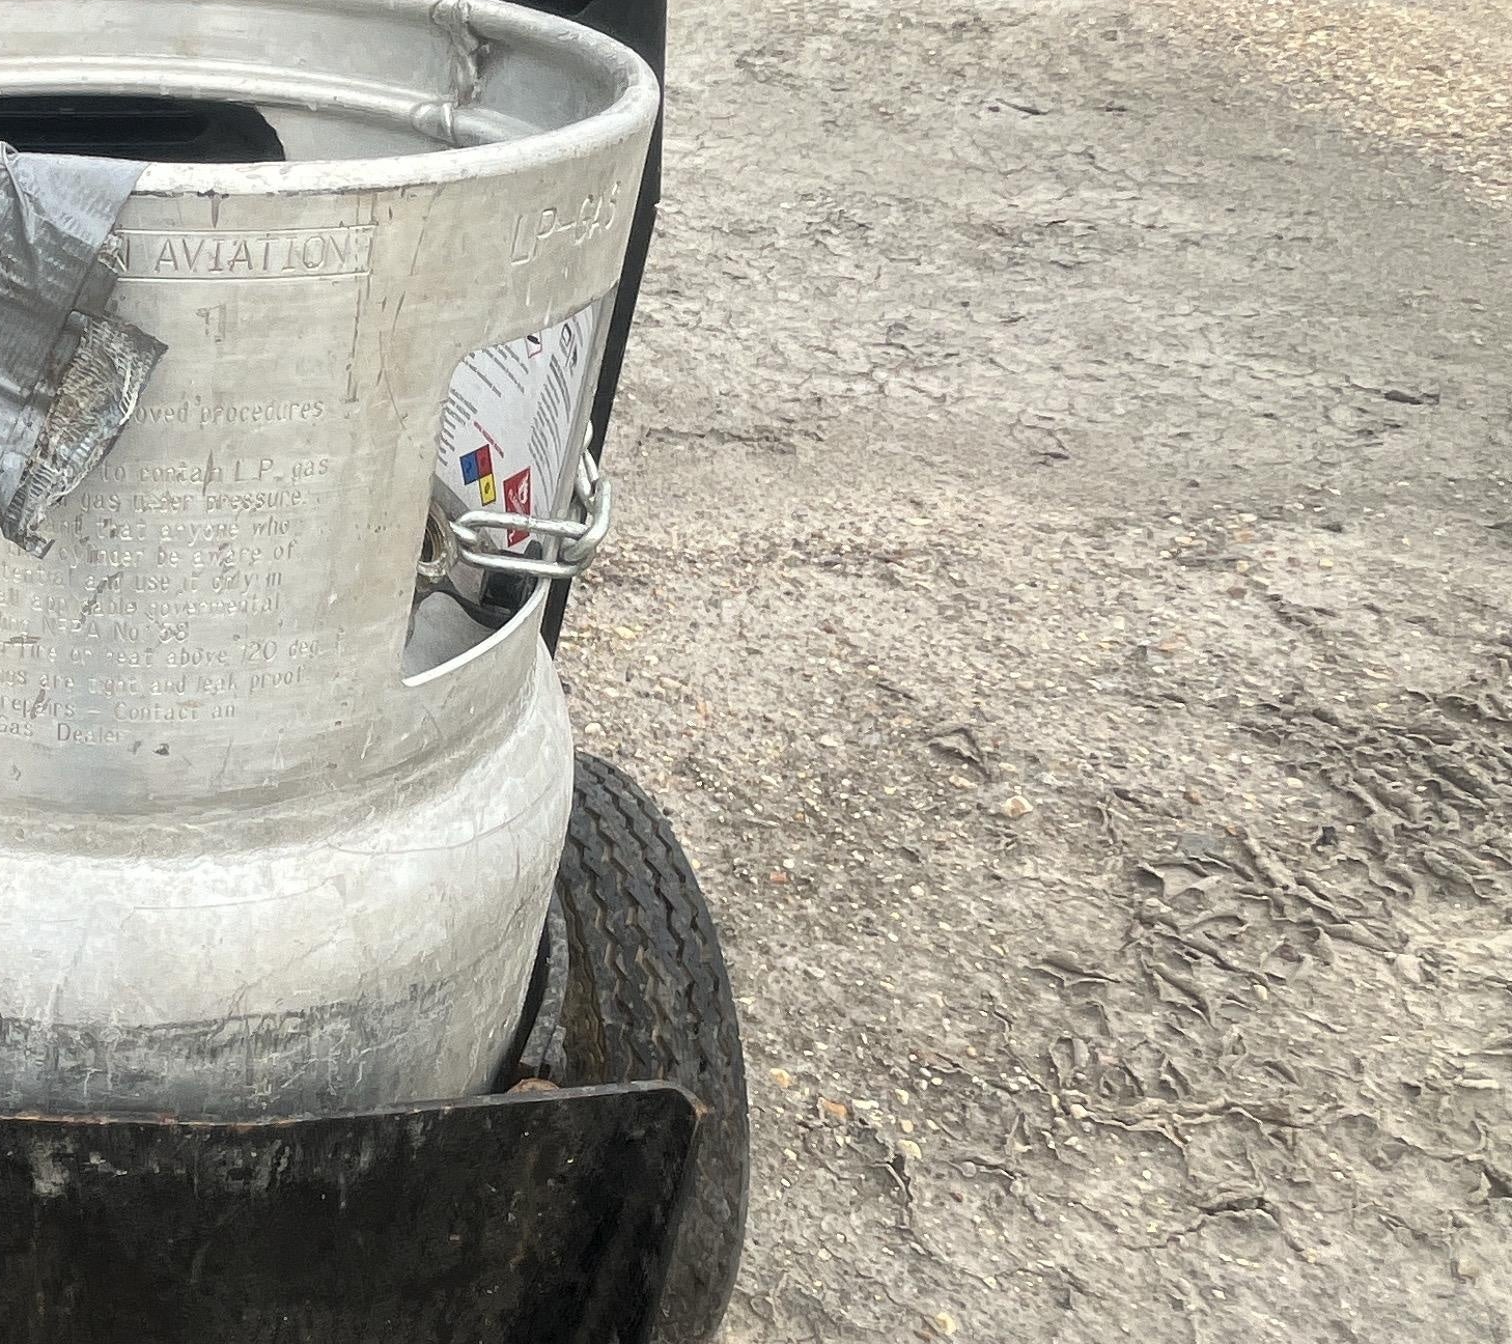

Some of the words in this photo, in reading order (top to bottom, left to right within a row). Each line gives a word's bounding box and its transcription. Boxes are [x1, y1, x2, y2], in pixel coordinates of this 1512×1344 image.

[154, 235, 350, 274] AVIATION
[201, 399, 325, 429] procedures
[81, 492, 121, 513] gas
[57, 722, 122, 745] Dealer
